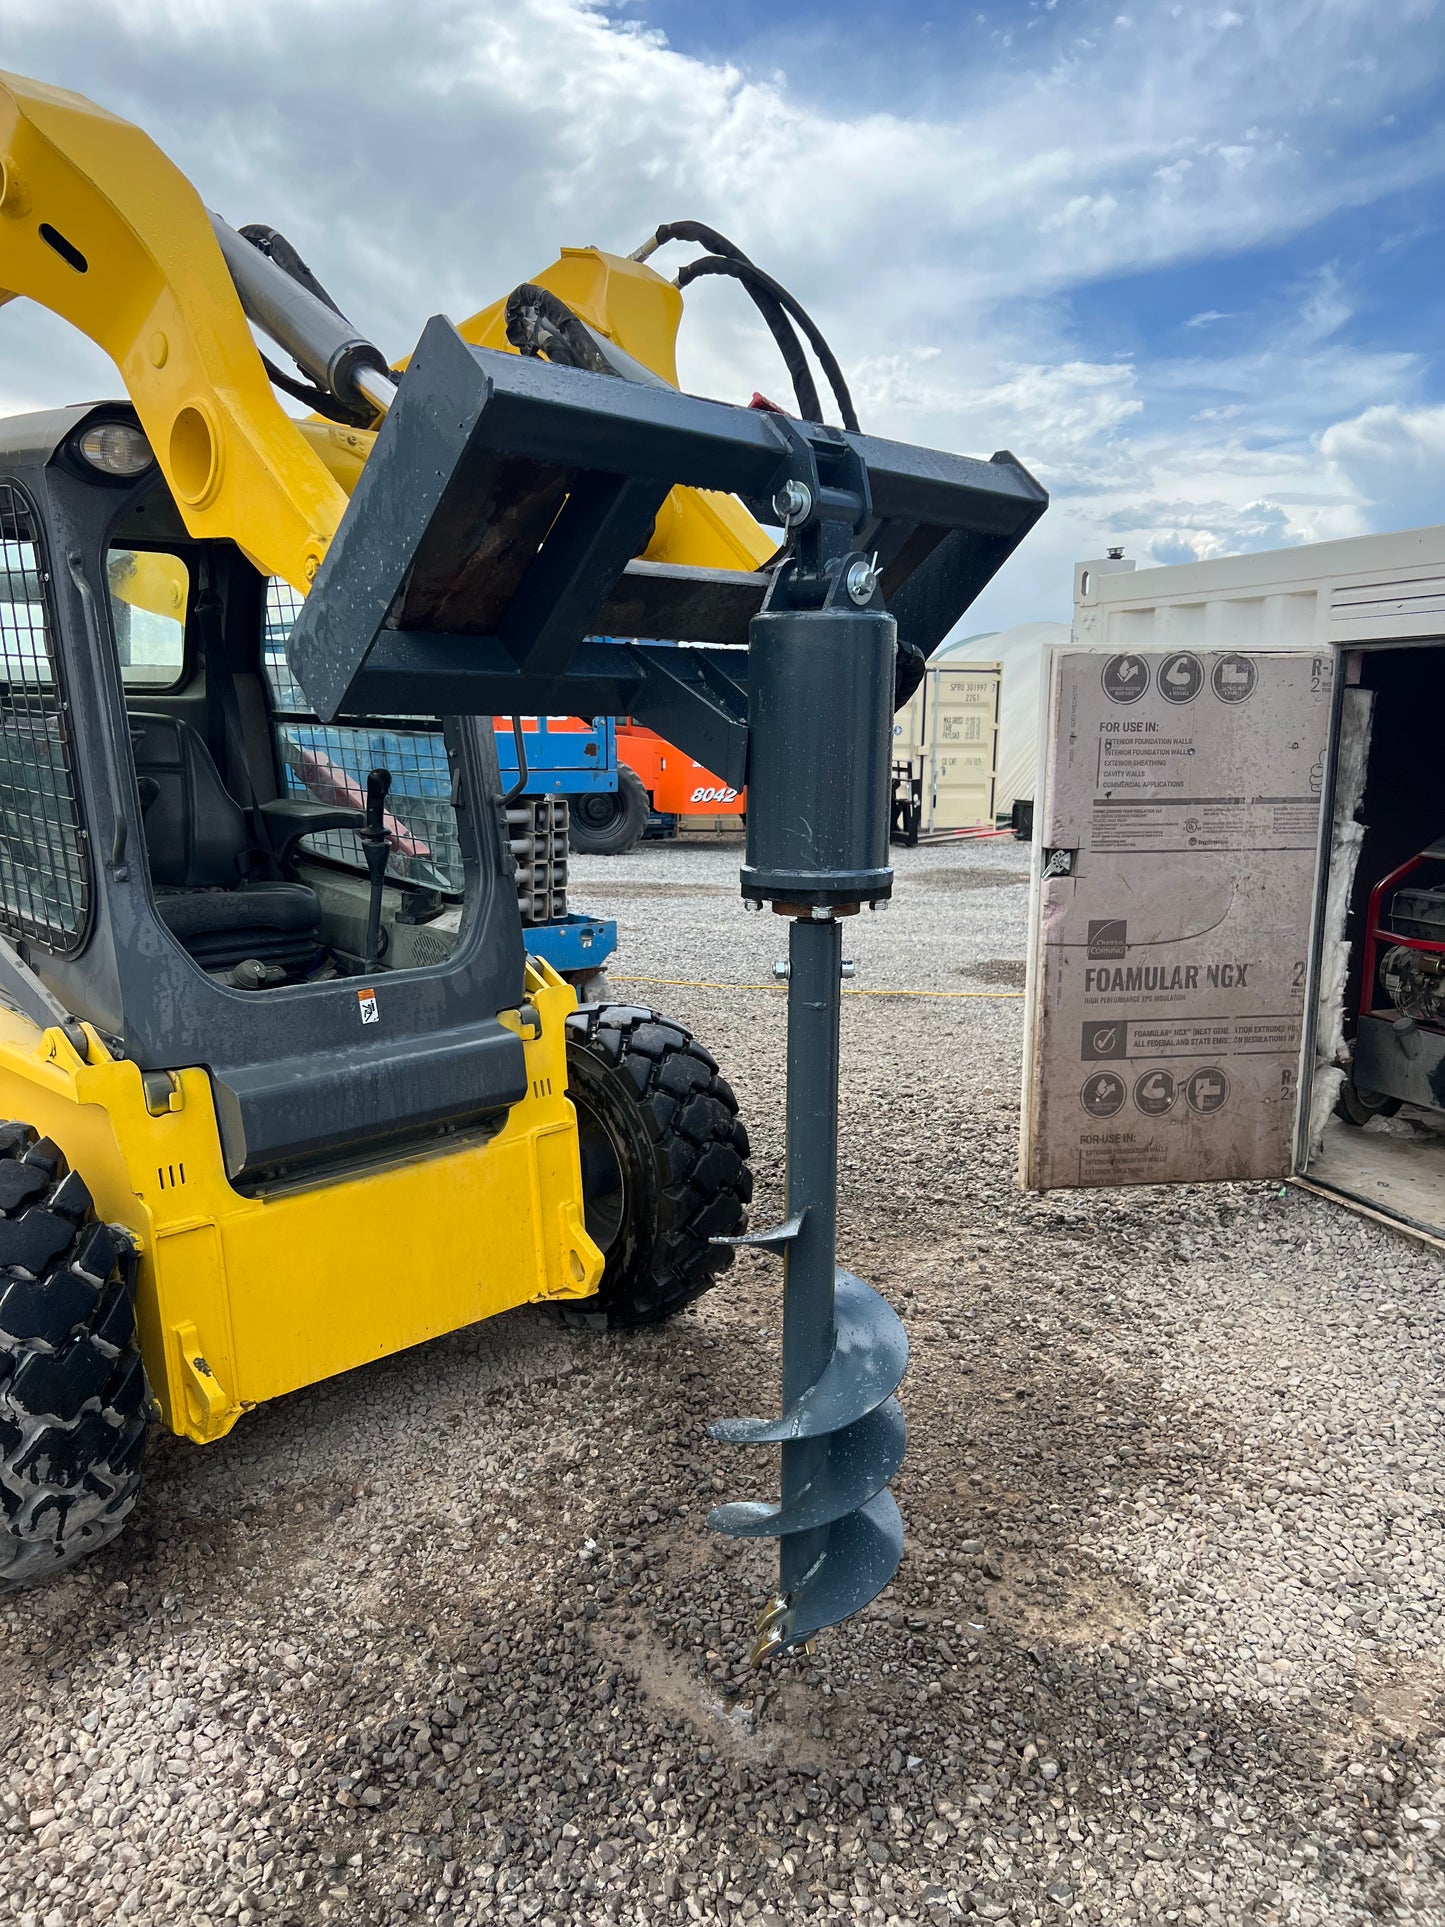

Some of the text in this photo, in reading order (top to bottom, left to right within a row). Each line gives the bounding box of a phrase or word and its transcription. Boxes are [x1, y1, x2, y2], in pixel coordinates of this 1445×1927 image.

[950, 683, 965, 692] SPRU
[966, 683, 987, 692] 301997
[1099, 721, 1160, 733] FOR USE IN:
[1173, 737, 1193, 745] WALLS
[1132, 759, 1167, 767] SHEATHING
[1103, 770, 1146, 778] CAVITY WALLS
[1142, 780, 1185, 788] APPLICATIONS
[690, 786, 738, 804] 8042
[1090, 946, 1124, 955] CORNING
[1100, 996, 1141, 1004] PERFORMANCE
[1212, 1026, 1253, 1035] GENEATION
[1134, 1039, 1146, 1048] ALL
[1190, 1038, 1211, 1046] STATE
[1080, 1132, 1137, 1145] FOR USE IN:
